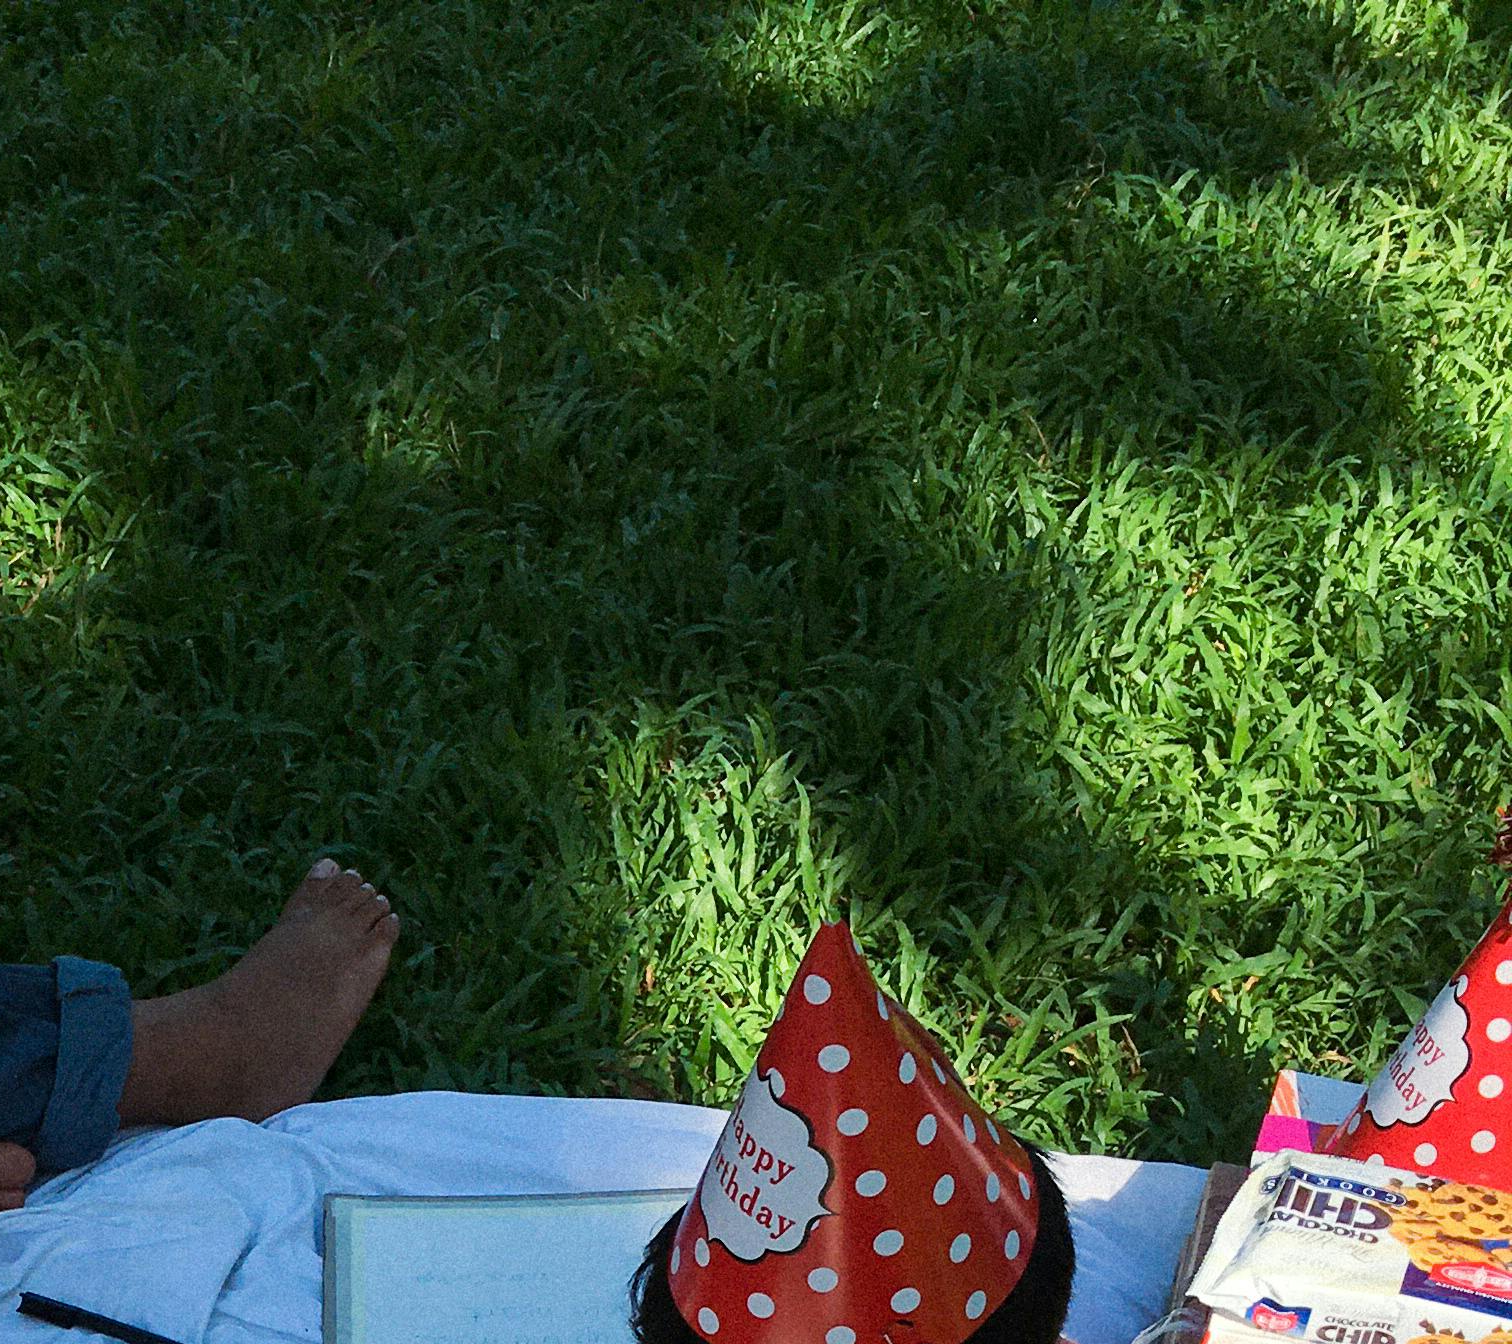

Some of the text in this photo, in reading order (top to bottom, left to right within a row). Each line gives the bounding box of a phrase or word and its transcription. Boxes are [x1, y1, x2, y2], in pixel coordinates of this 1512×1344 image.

[1413, 1019, 1445, 1066] appy
[716, 1145, 796, 1239] rthday
[1261, 1172, 1397, 1203] COOKIS
[1324, 1315, 1395, 1331] CHOCOLATE
